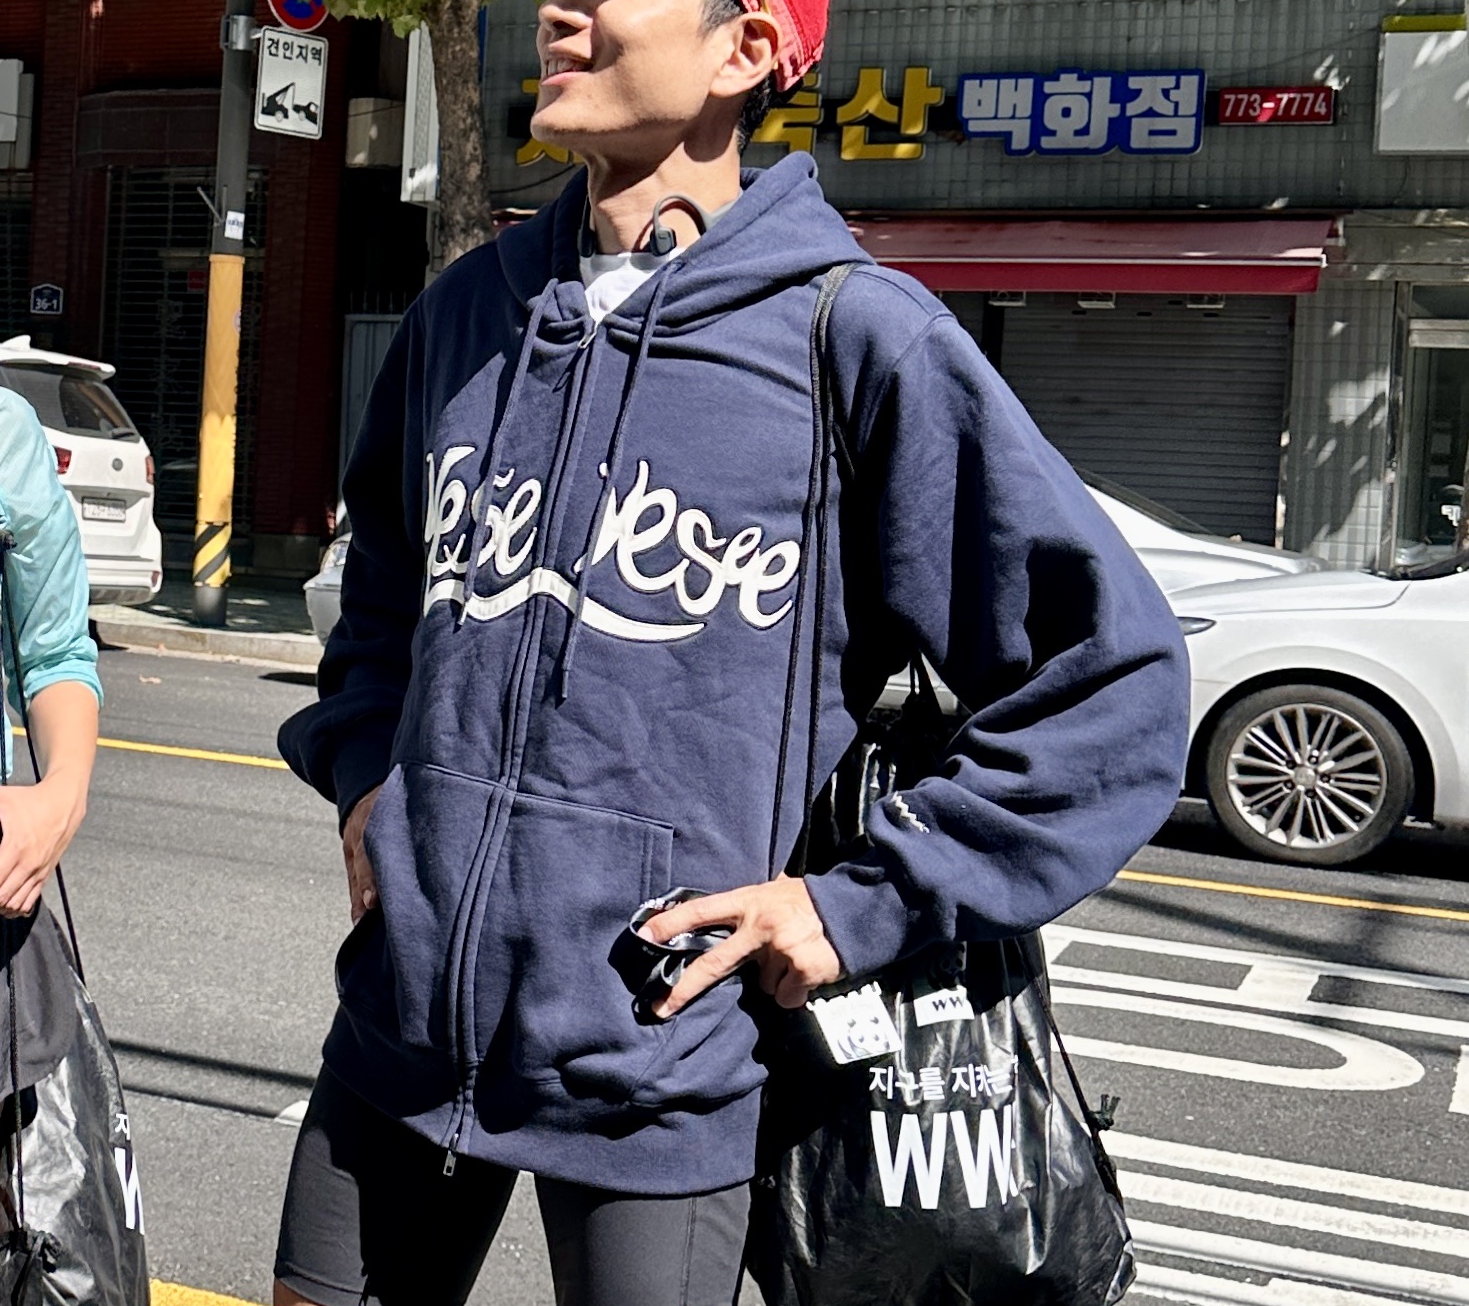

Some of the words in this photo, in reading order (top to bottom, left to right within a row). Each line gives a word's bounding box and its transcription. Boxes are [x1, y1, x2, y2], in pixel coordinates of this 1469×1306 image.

[267, 37, 323, 66] 견인지역
[962, 72, 1200, 152] 백화점
[1223, 92, 1328, 118] 773-7774
[35, 298, 58, 311] 36-1
[869, 1065, 946, 1101] 지구를
